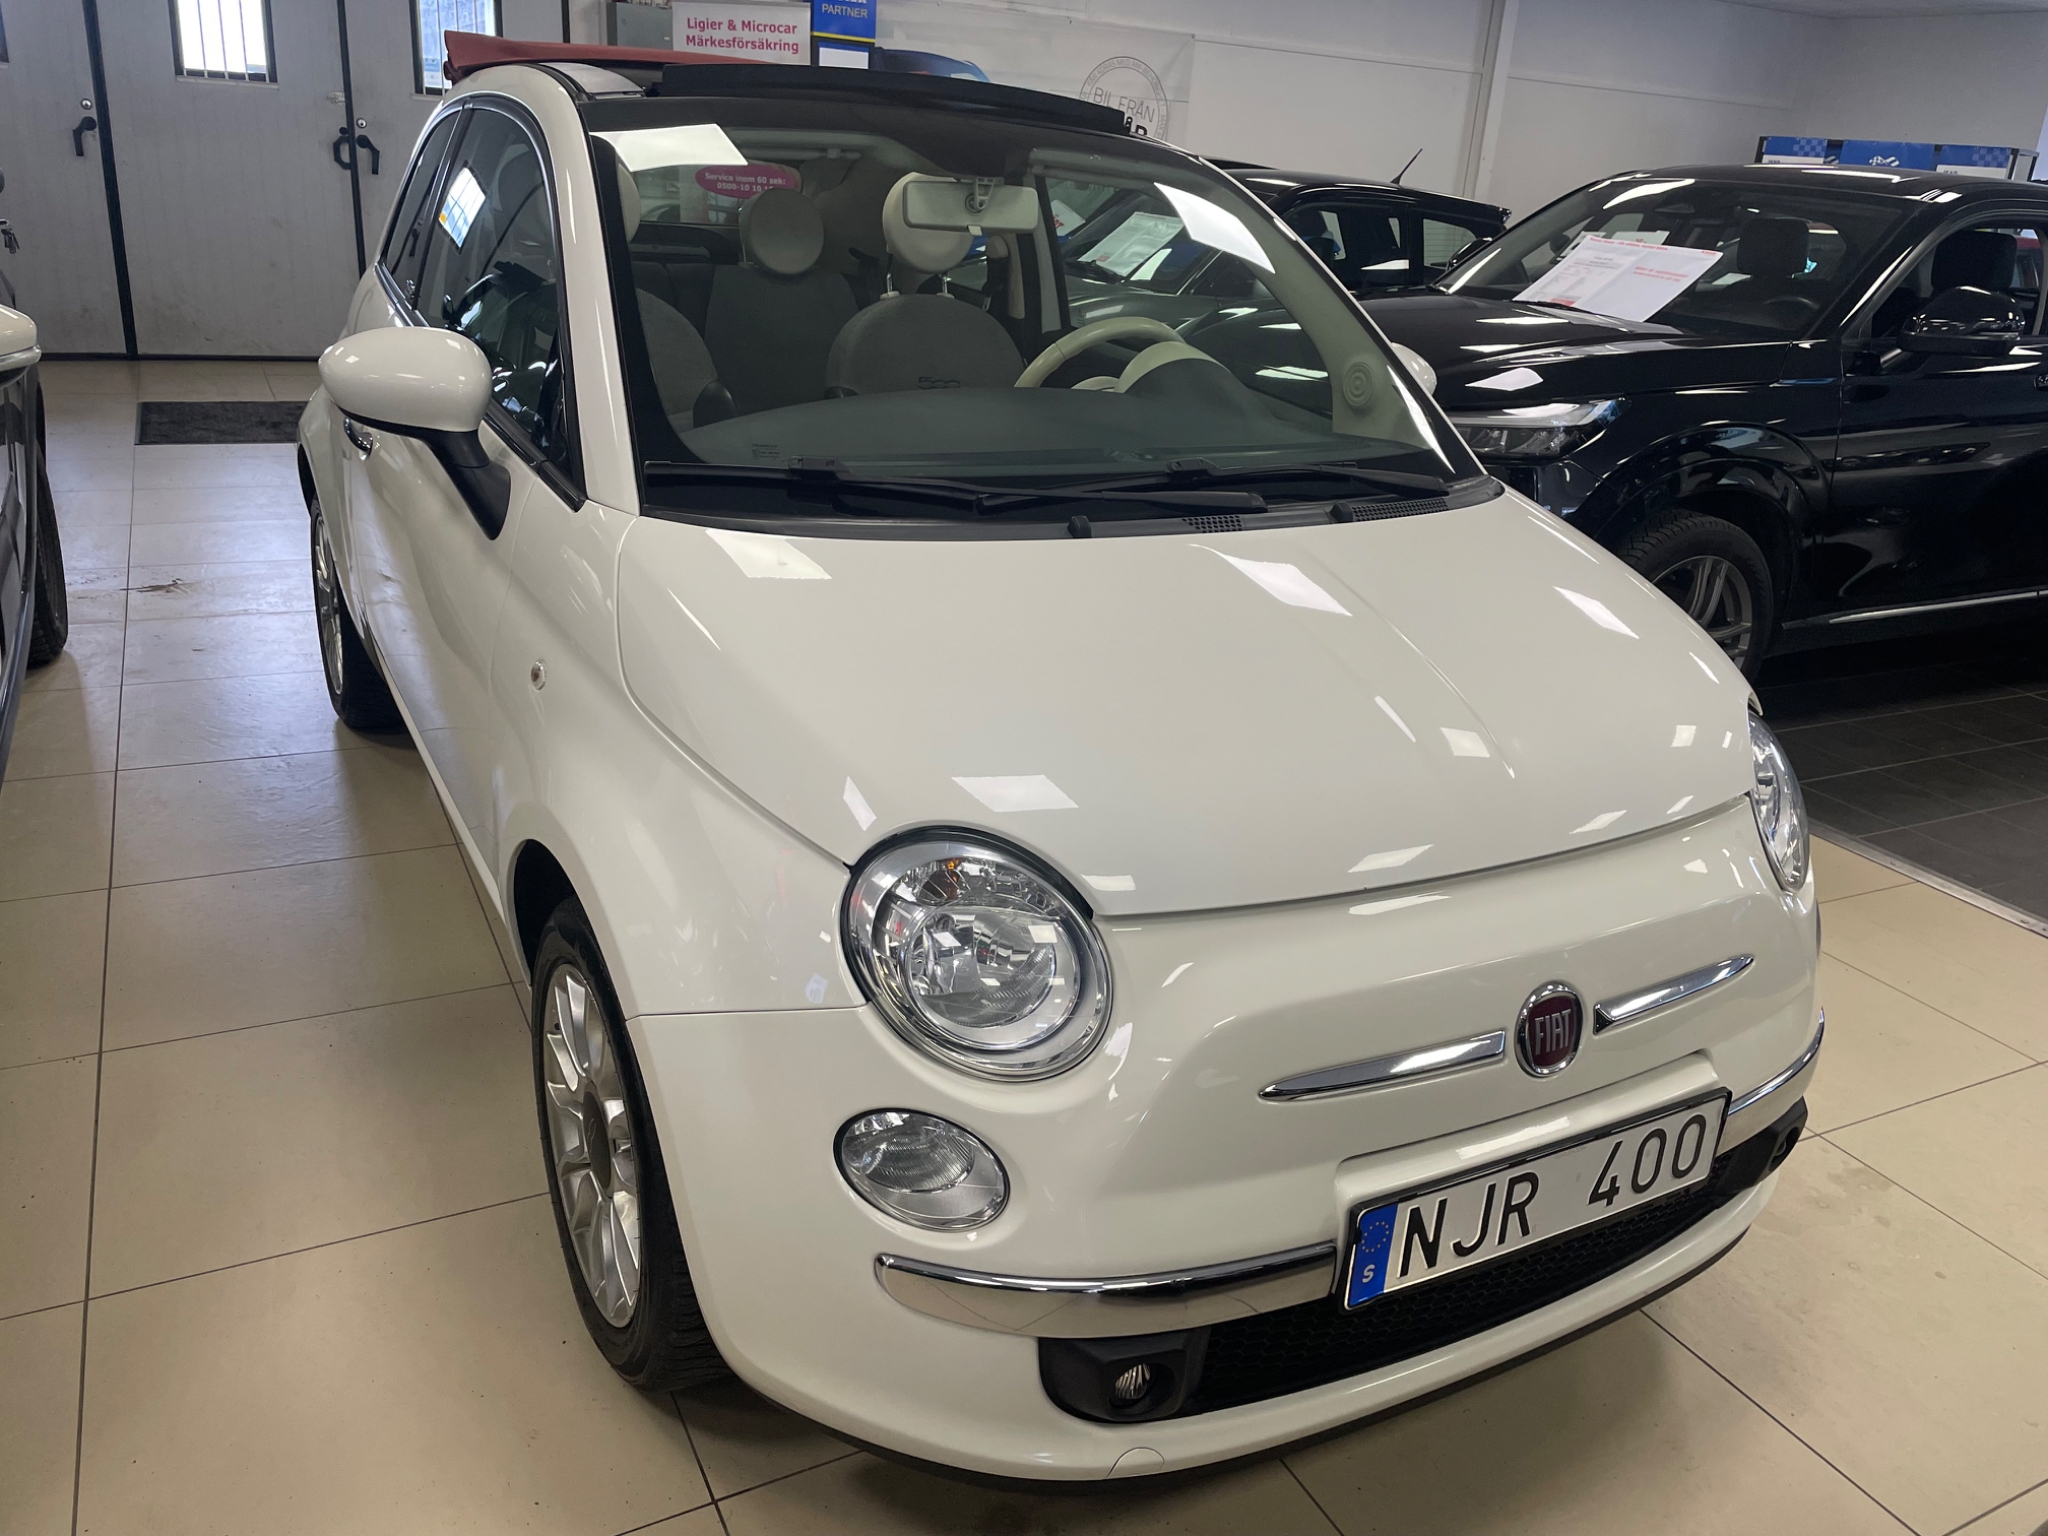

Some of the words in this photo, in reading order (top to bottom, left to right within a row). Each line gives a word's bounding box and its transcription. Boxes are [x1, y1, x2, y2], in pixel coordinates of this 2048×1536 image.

[822, 3, 868, 19] PARTNER
[687, 18, 723, 33] Ligier
[727, 19, 738, 31] &
[741, 20, 798, 34] Microcar
[686, 34, 799, 54] Märkesförsäkring
[1093, 86, 1112, 107] BIL
[1118, 95, 1155, 123] FRÅN
[705, 172, 734, 182] Service
[735, 174, 756, 184] inom
[757, 175, 767, 184] 60
[769, 177, 786, 186] sek:
[717, 182, 750, 191] 0500-10
[917, 376, 961, 390] 500
[1535, 1008, 1571, 1056] FIAT
[1398, 1172, 1539, 1278] NJR
[1588, 1114, 1707, 1208] 400
[1361, 1263, 1376, 1285] S
